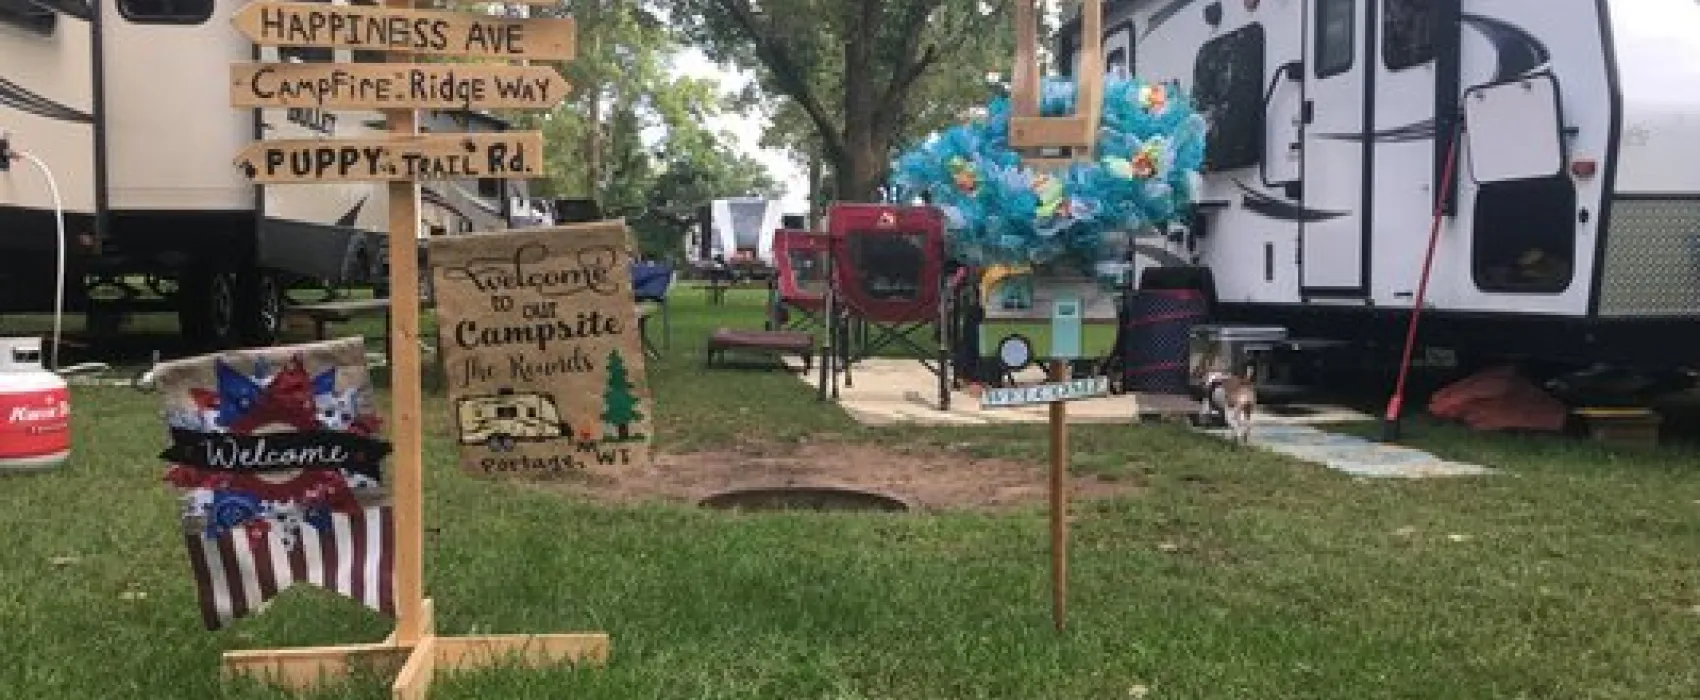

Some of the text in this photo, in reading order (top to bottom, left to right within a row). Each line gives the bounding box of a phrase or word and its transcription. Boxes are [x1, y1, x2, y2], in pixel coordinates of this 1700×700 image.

[261, 8, 524, 54] HAPPINESS AVE
[266, 140, 533, 178] PUPPY TRAIL Rd.
[456, 311, 622, 350] Campsite
[206, 435, 349, 467] Welcome
